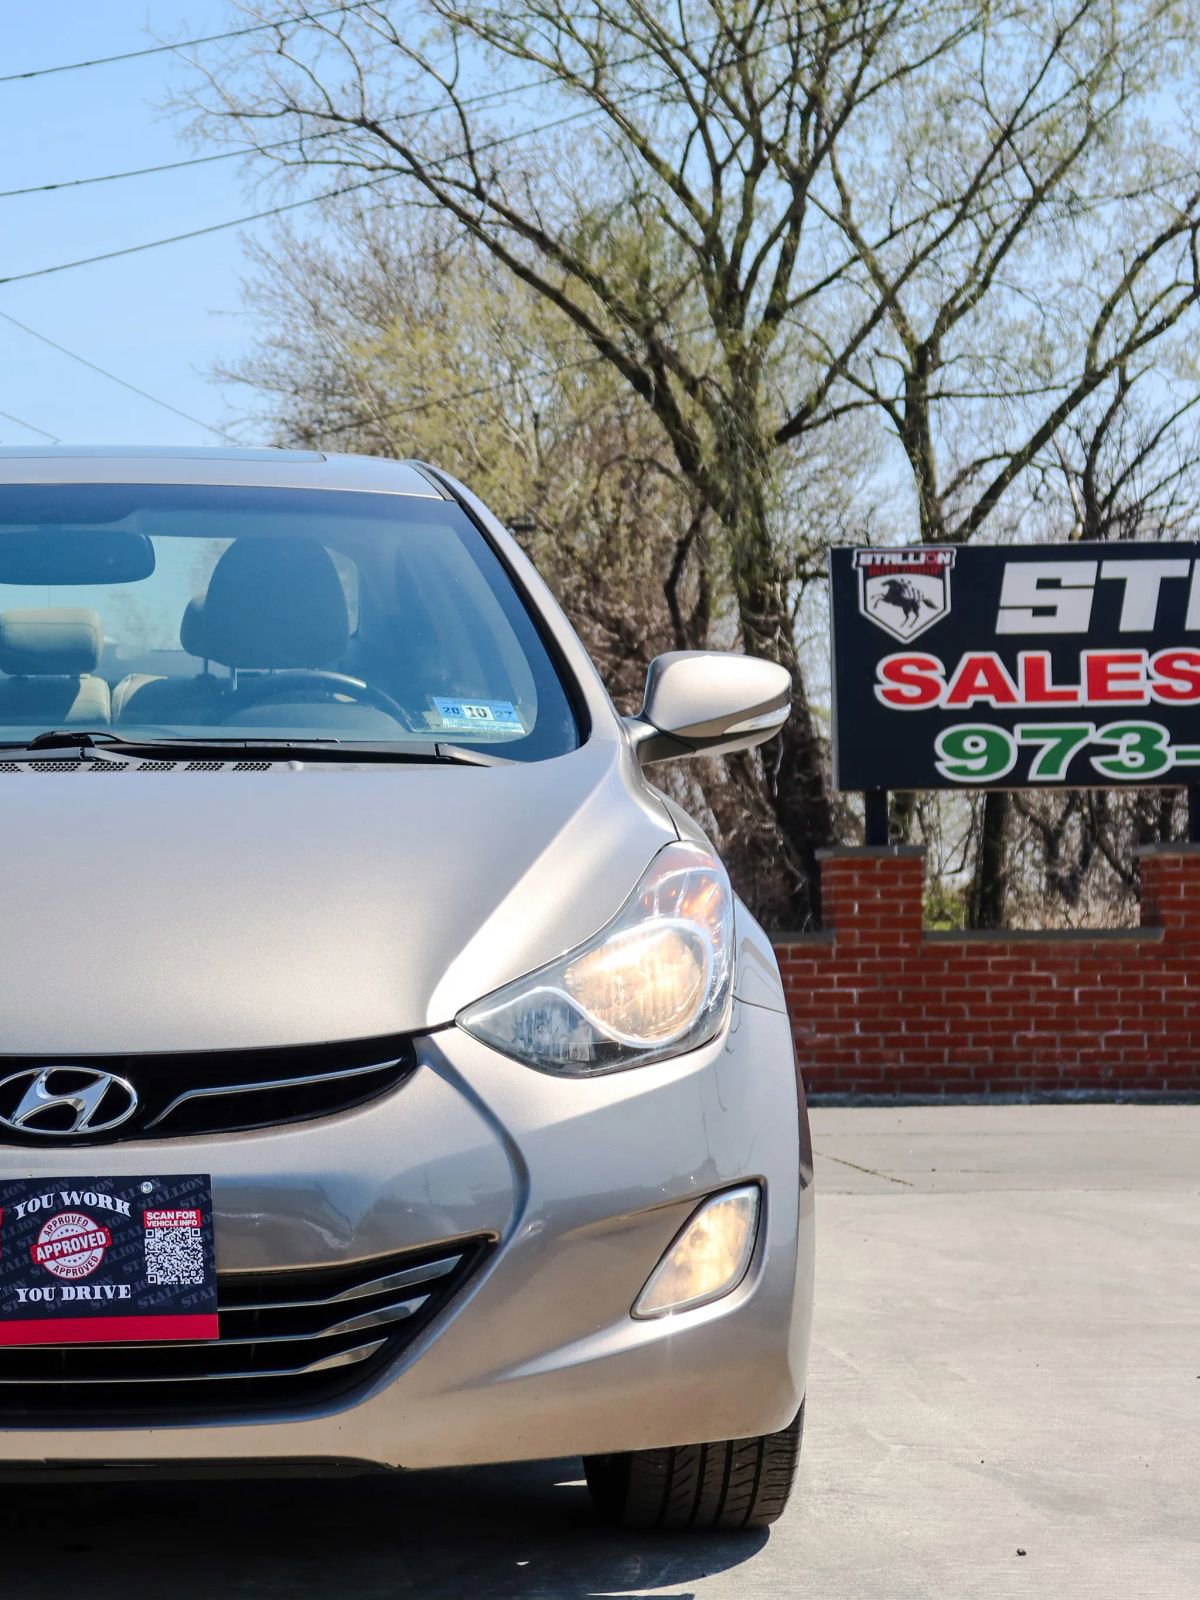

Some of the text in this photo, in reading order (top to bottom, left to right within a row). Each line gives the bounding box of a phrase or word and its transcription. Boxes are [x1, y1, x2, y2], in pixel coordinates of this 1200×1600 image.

[995, 558, 1200, 635] ST
[874, 647, 1200, 711] SALES
[466, 706, 488, 718] 10
[13, 1192, 56, 1220] YOU
[59, 1190, 133, 1218] WORK
[146, 1211, 197, 1220] SCAN FOR
[43, 1215, 89, 1237] APPROVED
[146, 1219, 179, 1227] VEHICLE
[36, 1231, 107, 1262] APPROVED
[52, 1255, 99, 1277] APPROVED
[14, 1284, 132, 1303] YOU DRIVE
